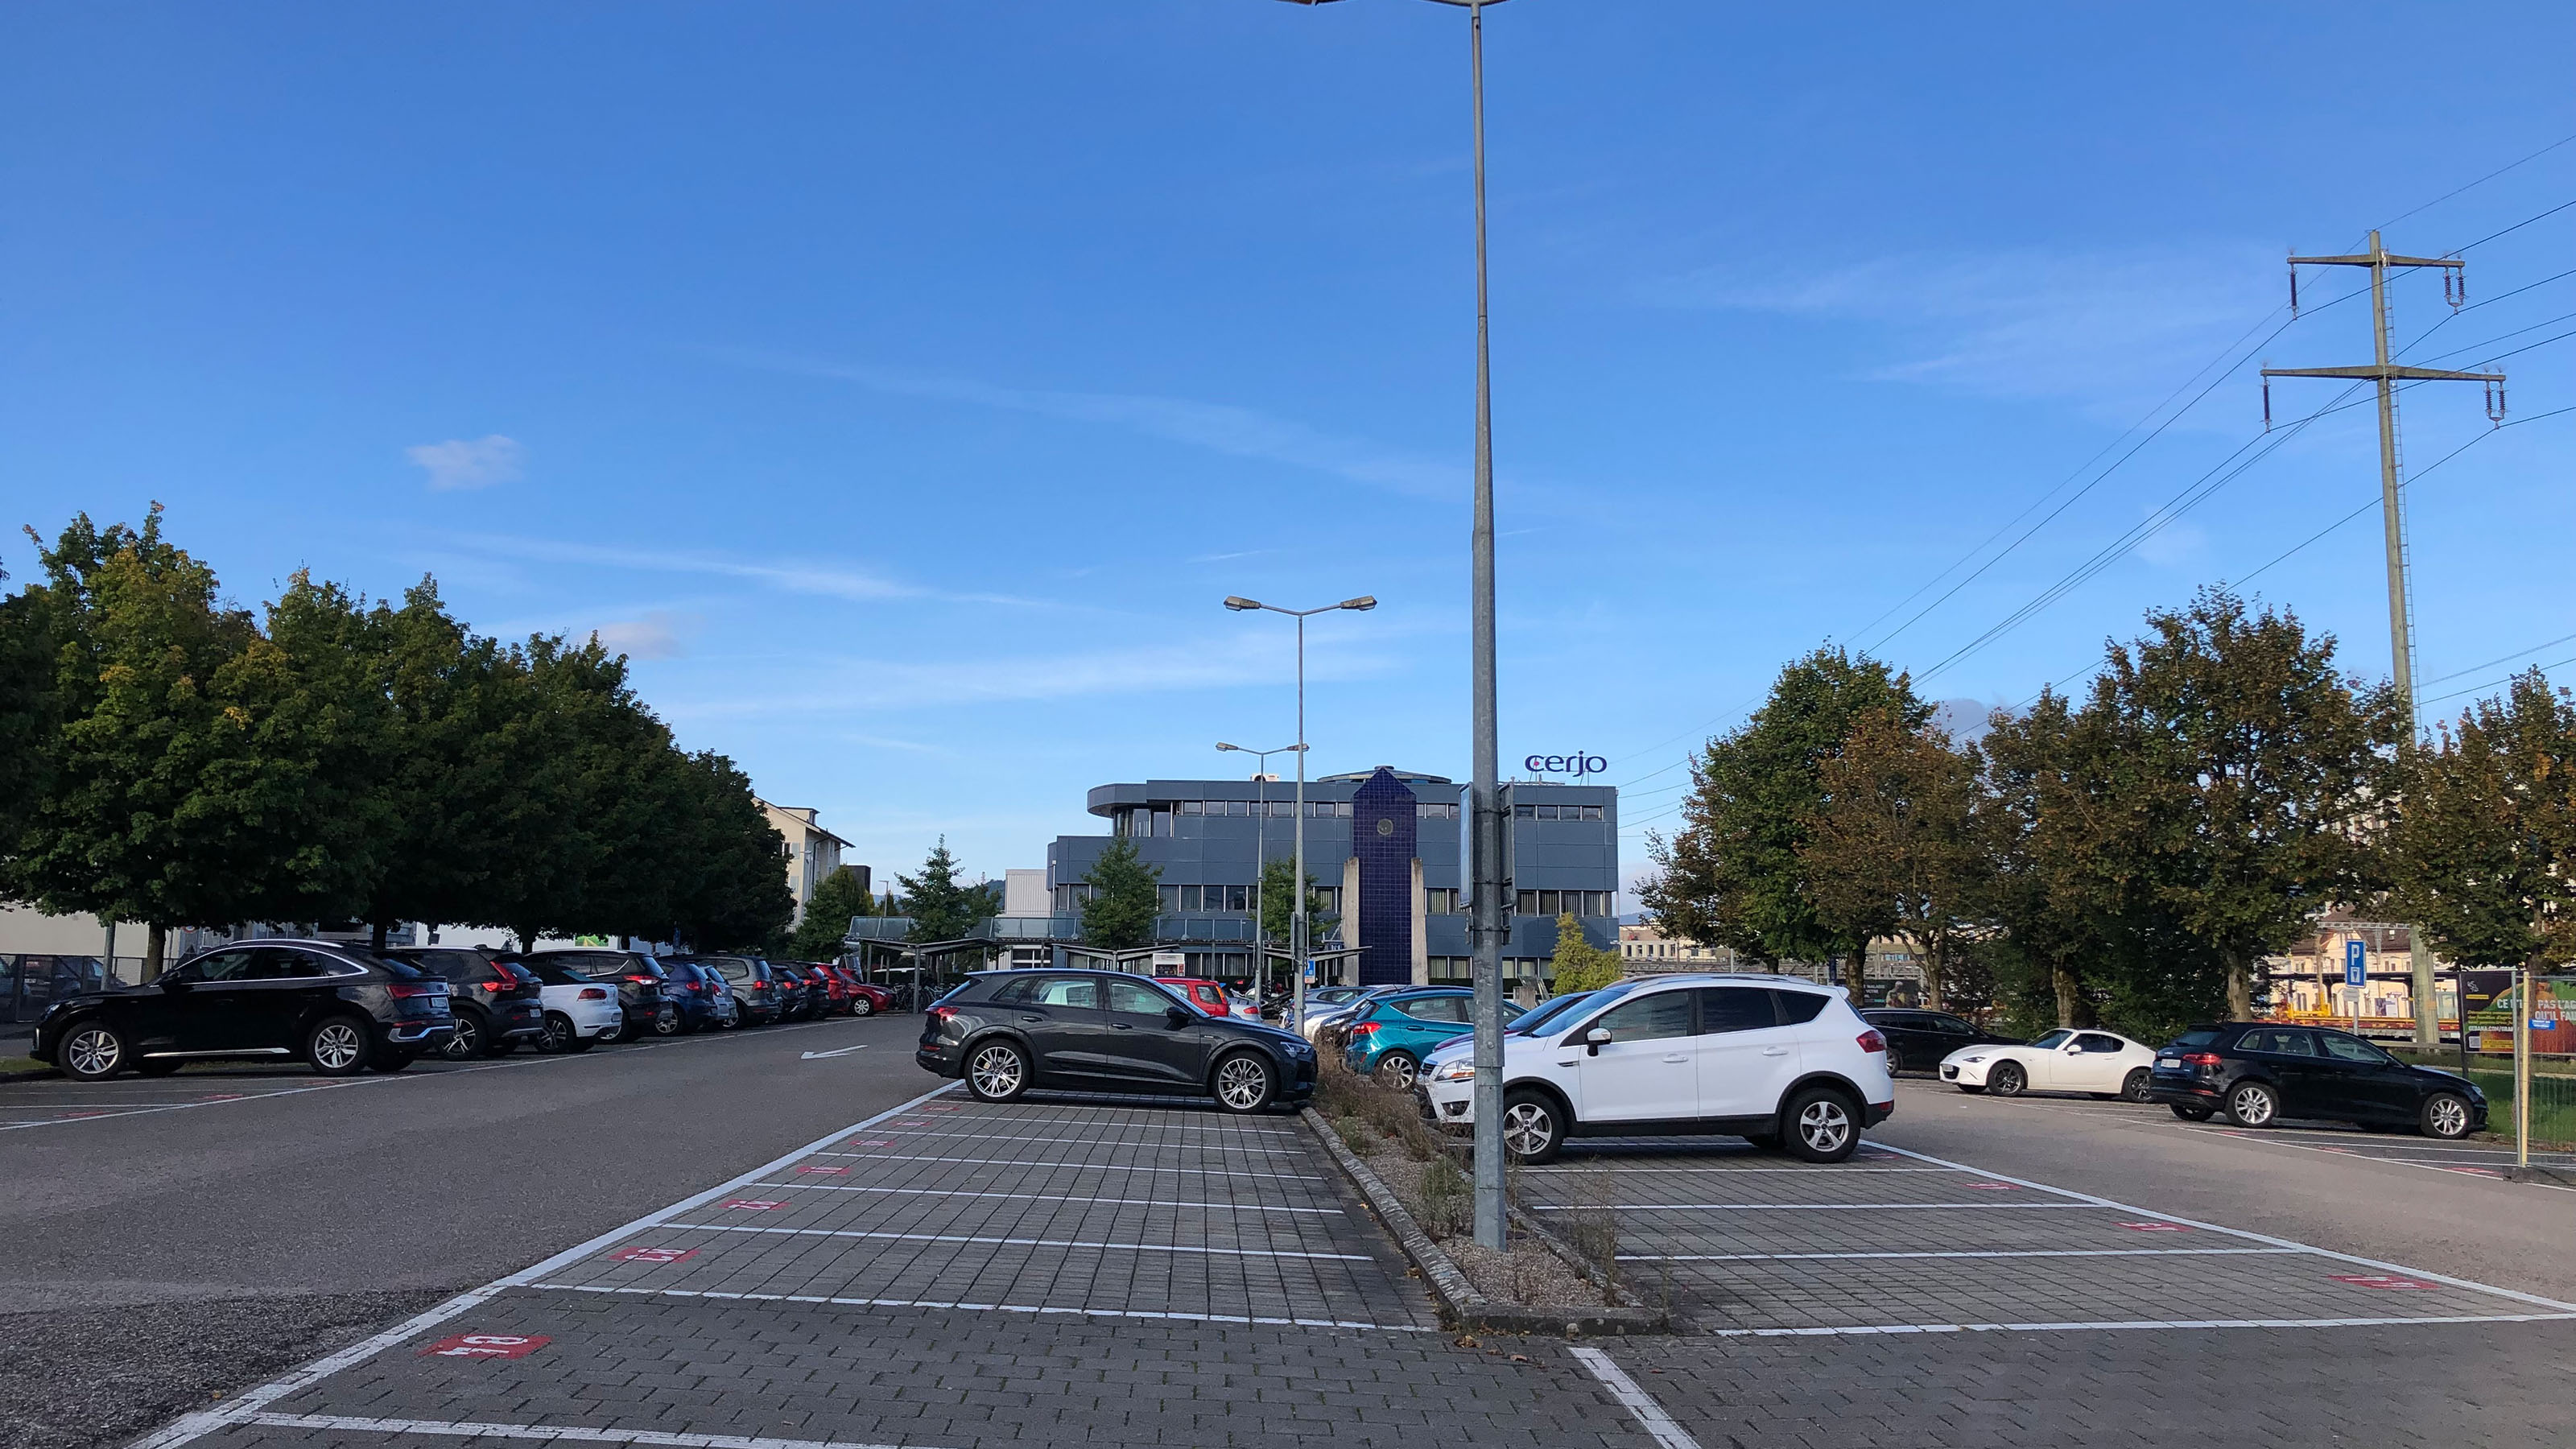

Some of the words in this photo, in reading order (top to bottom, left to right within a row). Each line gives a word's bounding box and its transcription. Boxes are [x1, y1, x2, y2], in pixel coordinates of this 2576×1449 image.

[1525, 750, 1608, 777] cerjo
[2351, 944, 2359, 966] P
[2496, 999, 2508, 1009] CE
[2537, 1000, 2556, 1009] PAS
